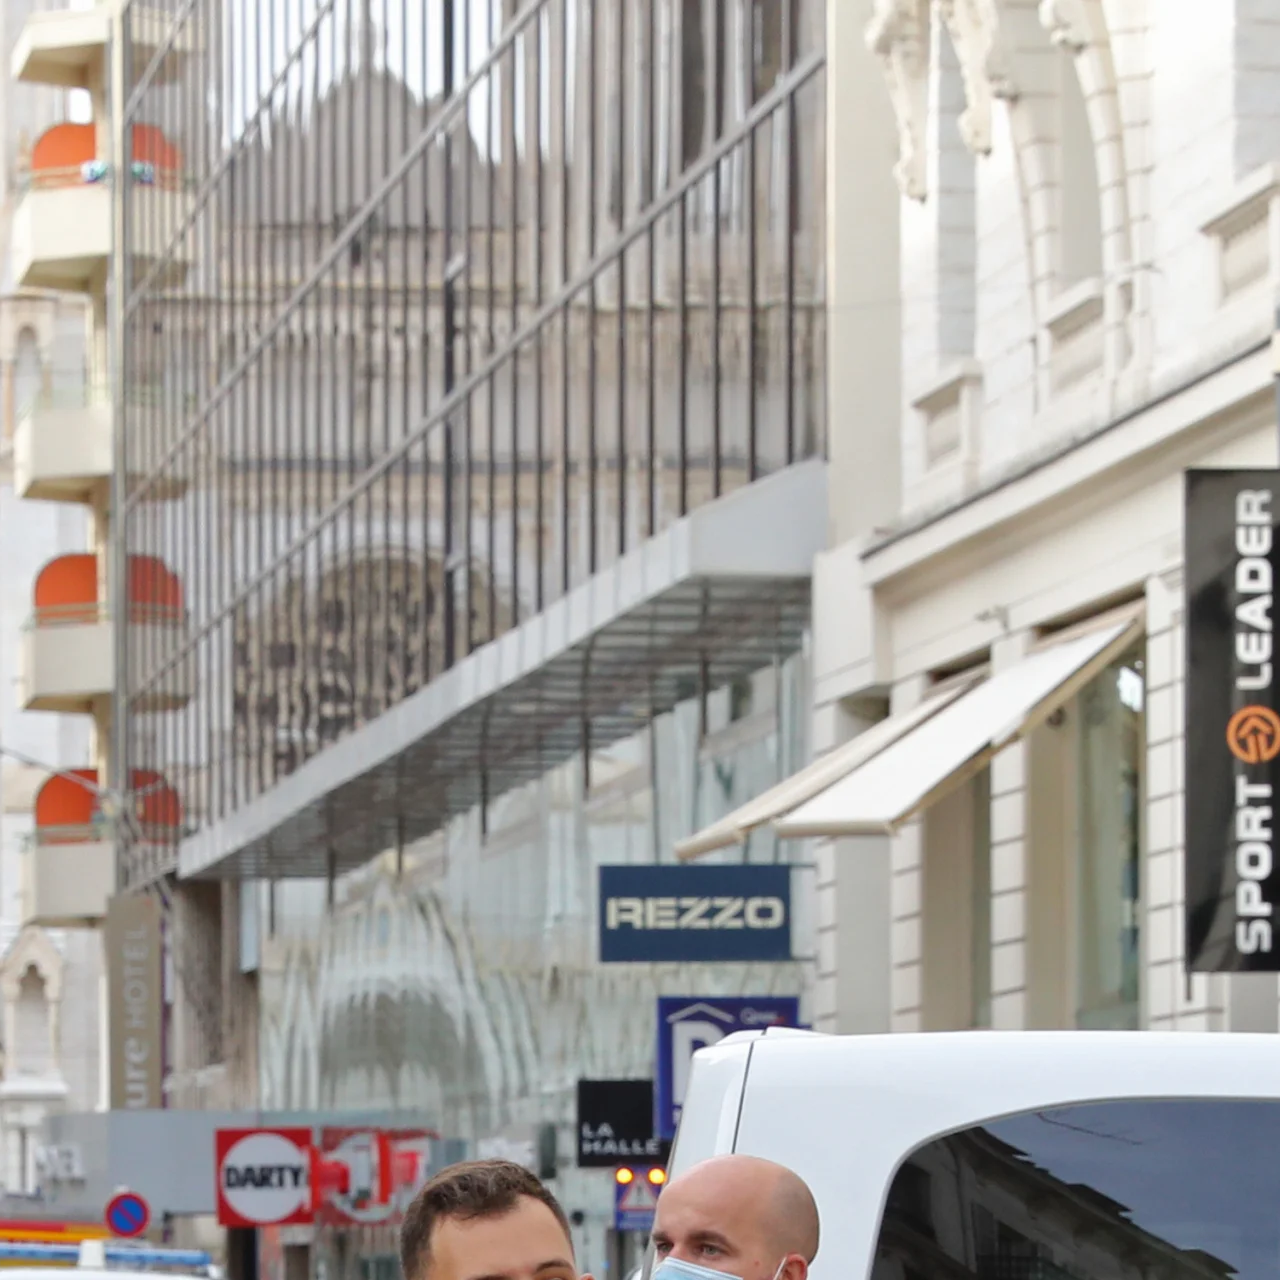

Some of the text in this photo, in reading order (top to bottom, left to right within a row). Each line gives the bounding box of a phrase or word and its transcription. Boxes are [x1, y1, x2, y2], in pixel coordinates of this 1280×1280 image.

[1235, 488, 1273, 954] SPORT LEADER
[606, 896, 785, 930] REZZO
[582, 1122, 613, 1139] LA
[582, 1139, 661, 1155] HALLE
[227, 1166, 303, 1187] DARTY
